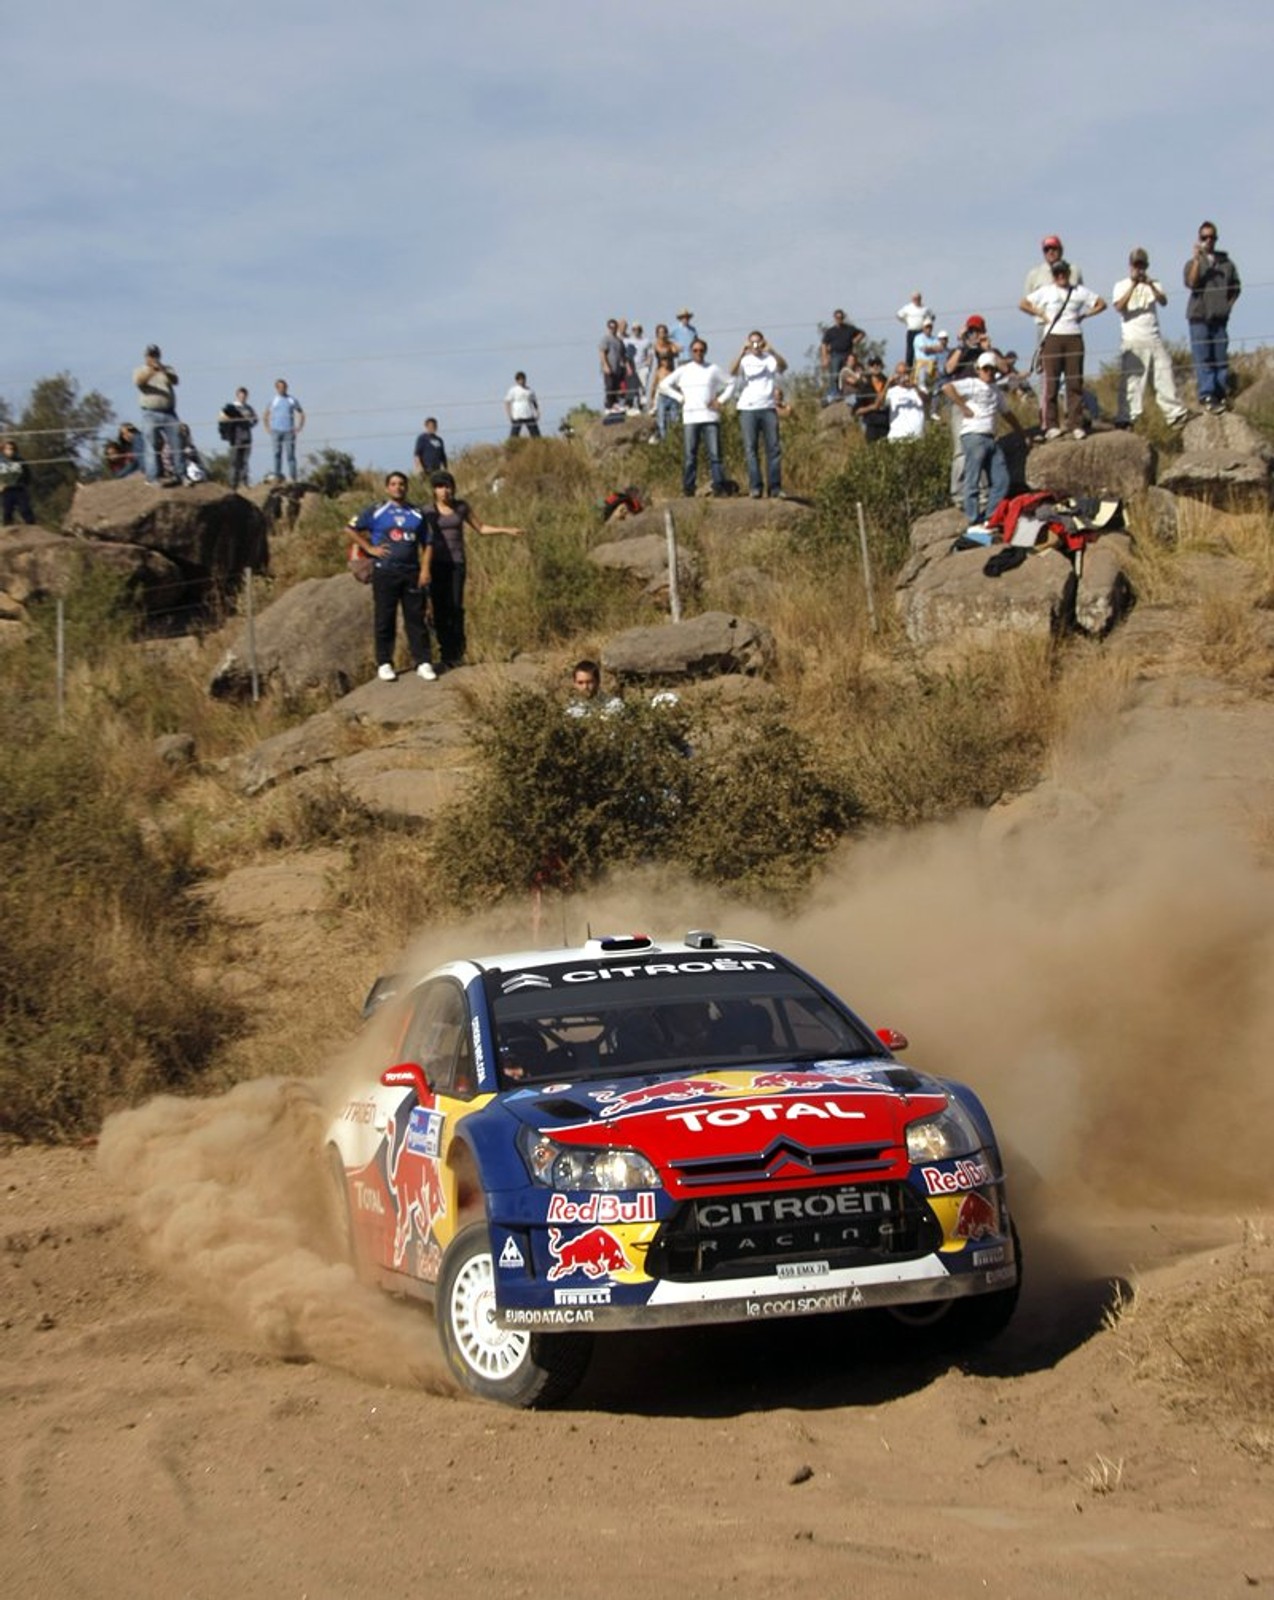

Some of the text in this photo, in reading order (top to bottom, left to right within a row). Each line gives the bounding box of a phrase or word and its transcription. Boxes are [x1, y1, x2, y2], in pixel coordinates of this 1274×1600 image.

[666, 1102, 866, 1132] TOTAL
[554, 1288, 611, 1305] PIRELLI
[746, 1300, 761, 1316] le
[797, 1289, 847, 1312] sportif
[505, 1309, 595, 1323] EURODATACAR
